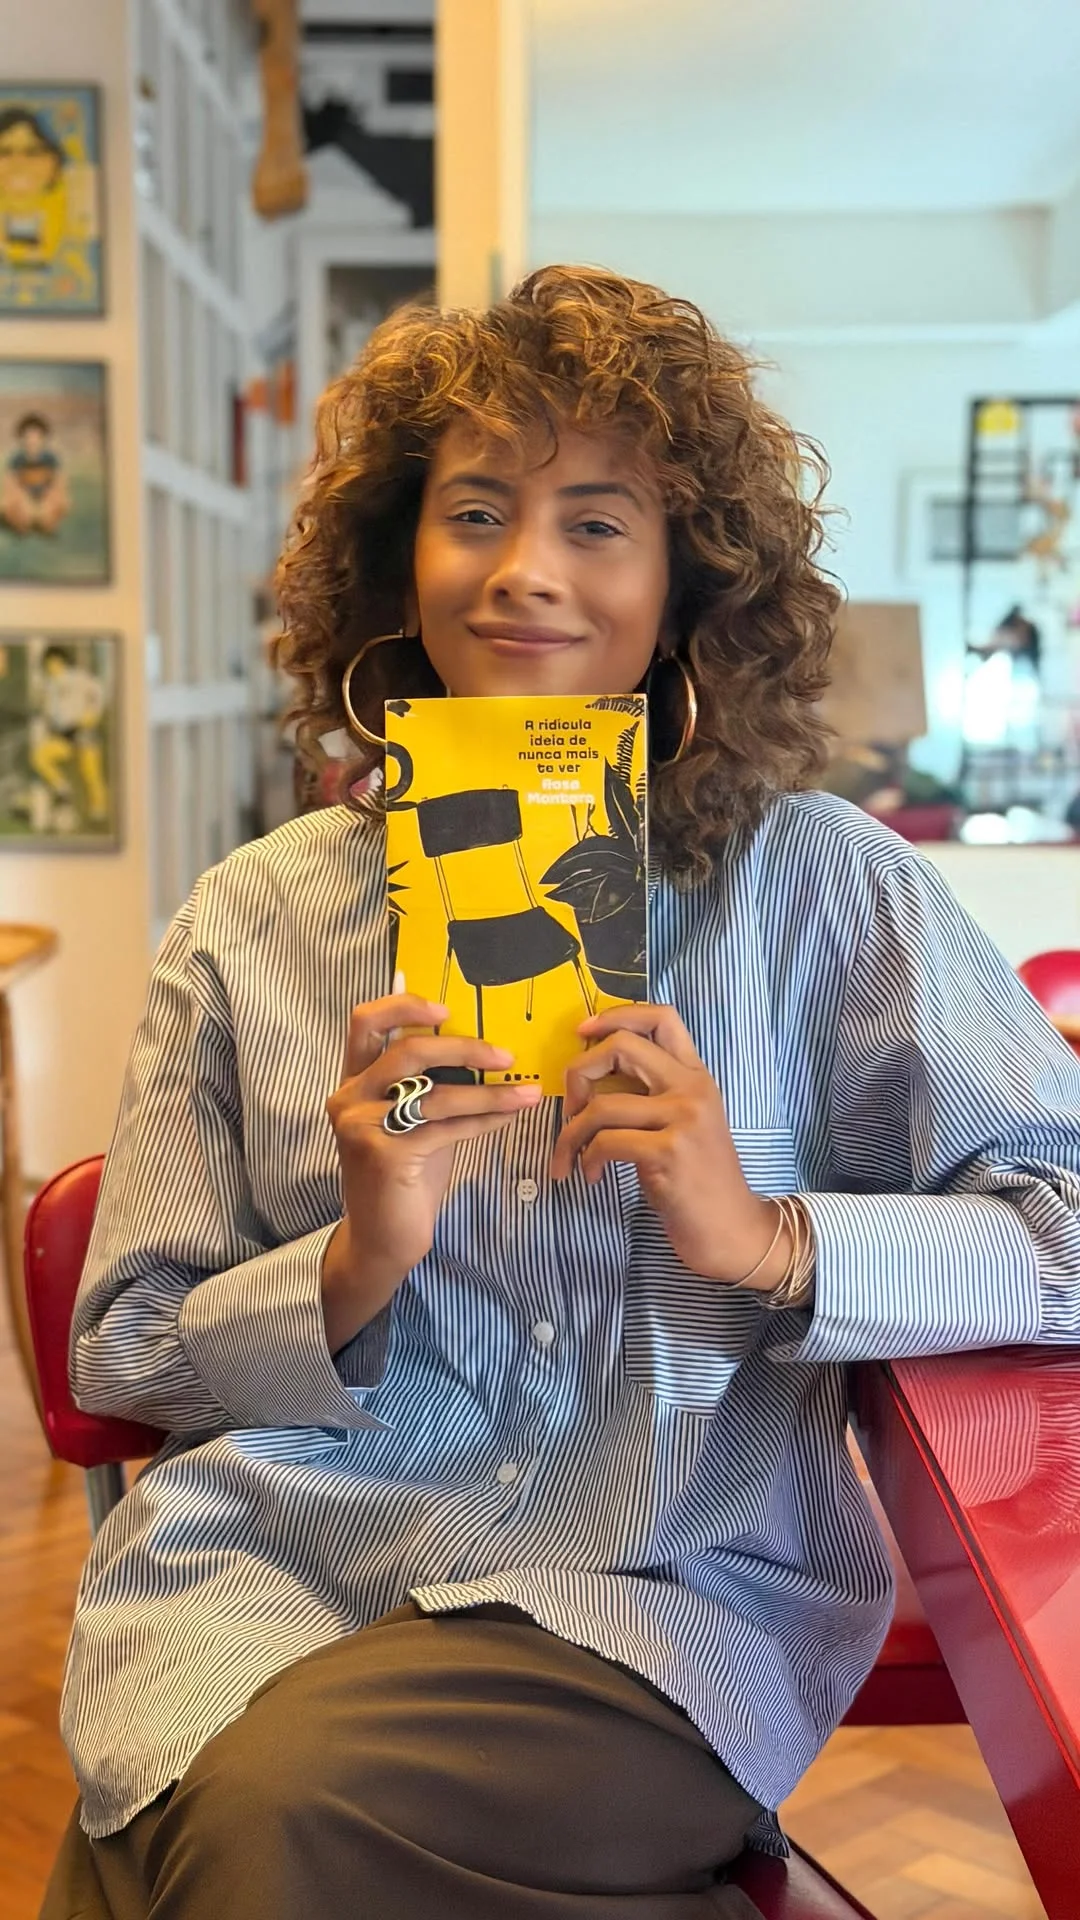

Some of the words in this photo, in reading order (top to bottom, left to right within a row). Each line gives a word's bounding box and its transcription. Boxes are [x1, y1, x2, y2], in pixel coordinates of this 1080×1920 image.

[525, 720, 534, 730] A
[530, 734, 565, 746] ideia
[569, 734, 587, 746] de
[518, 751, 562, 760] nunca
[566, 747, 599, 759] mais
[558, 764, 581, 773] ver
